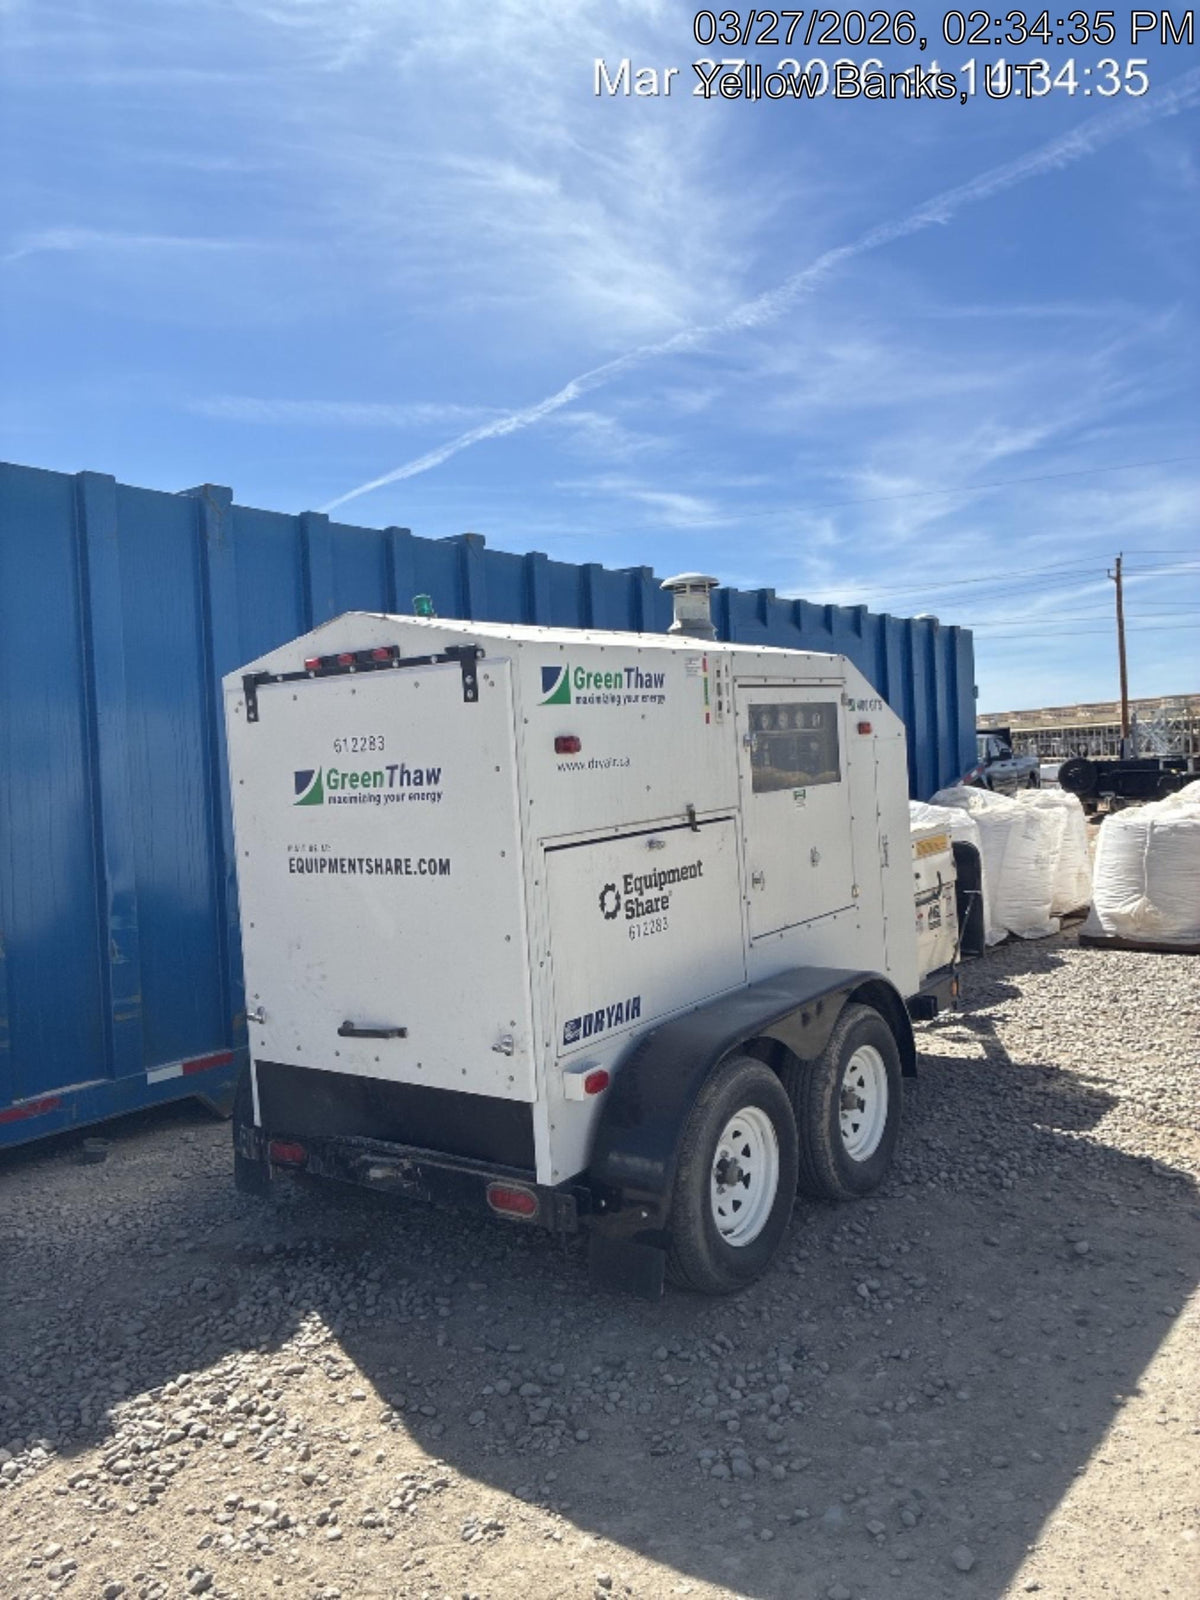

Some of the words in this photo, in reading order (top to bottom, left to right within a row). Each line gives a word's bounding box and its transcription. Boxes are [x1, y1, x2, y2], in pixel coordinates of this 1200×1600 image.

[573, 666, 665, 690] GreenThaw
[333, 735, 385, 754] 612283
[326, 763, 442, 790] GreenThaw
[328, 792, 381, 806] maximizing
[383, 792, 406, 806] your
[408, 790, 444, 804] energy
[288, 858, 451, 876] EQUIPMENTSHARE.COM
[622, 859, 704, 896] Equipment
[624, 894, 669, 920] Share
[628, 916, 669, 941] 612283
[583, 995, 641, 1038] DRYAIR
